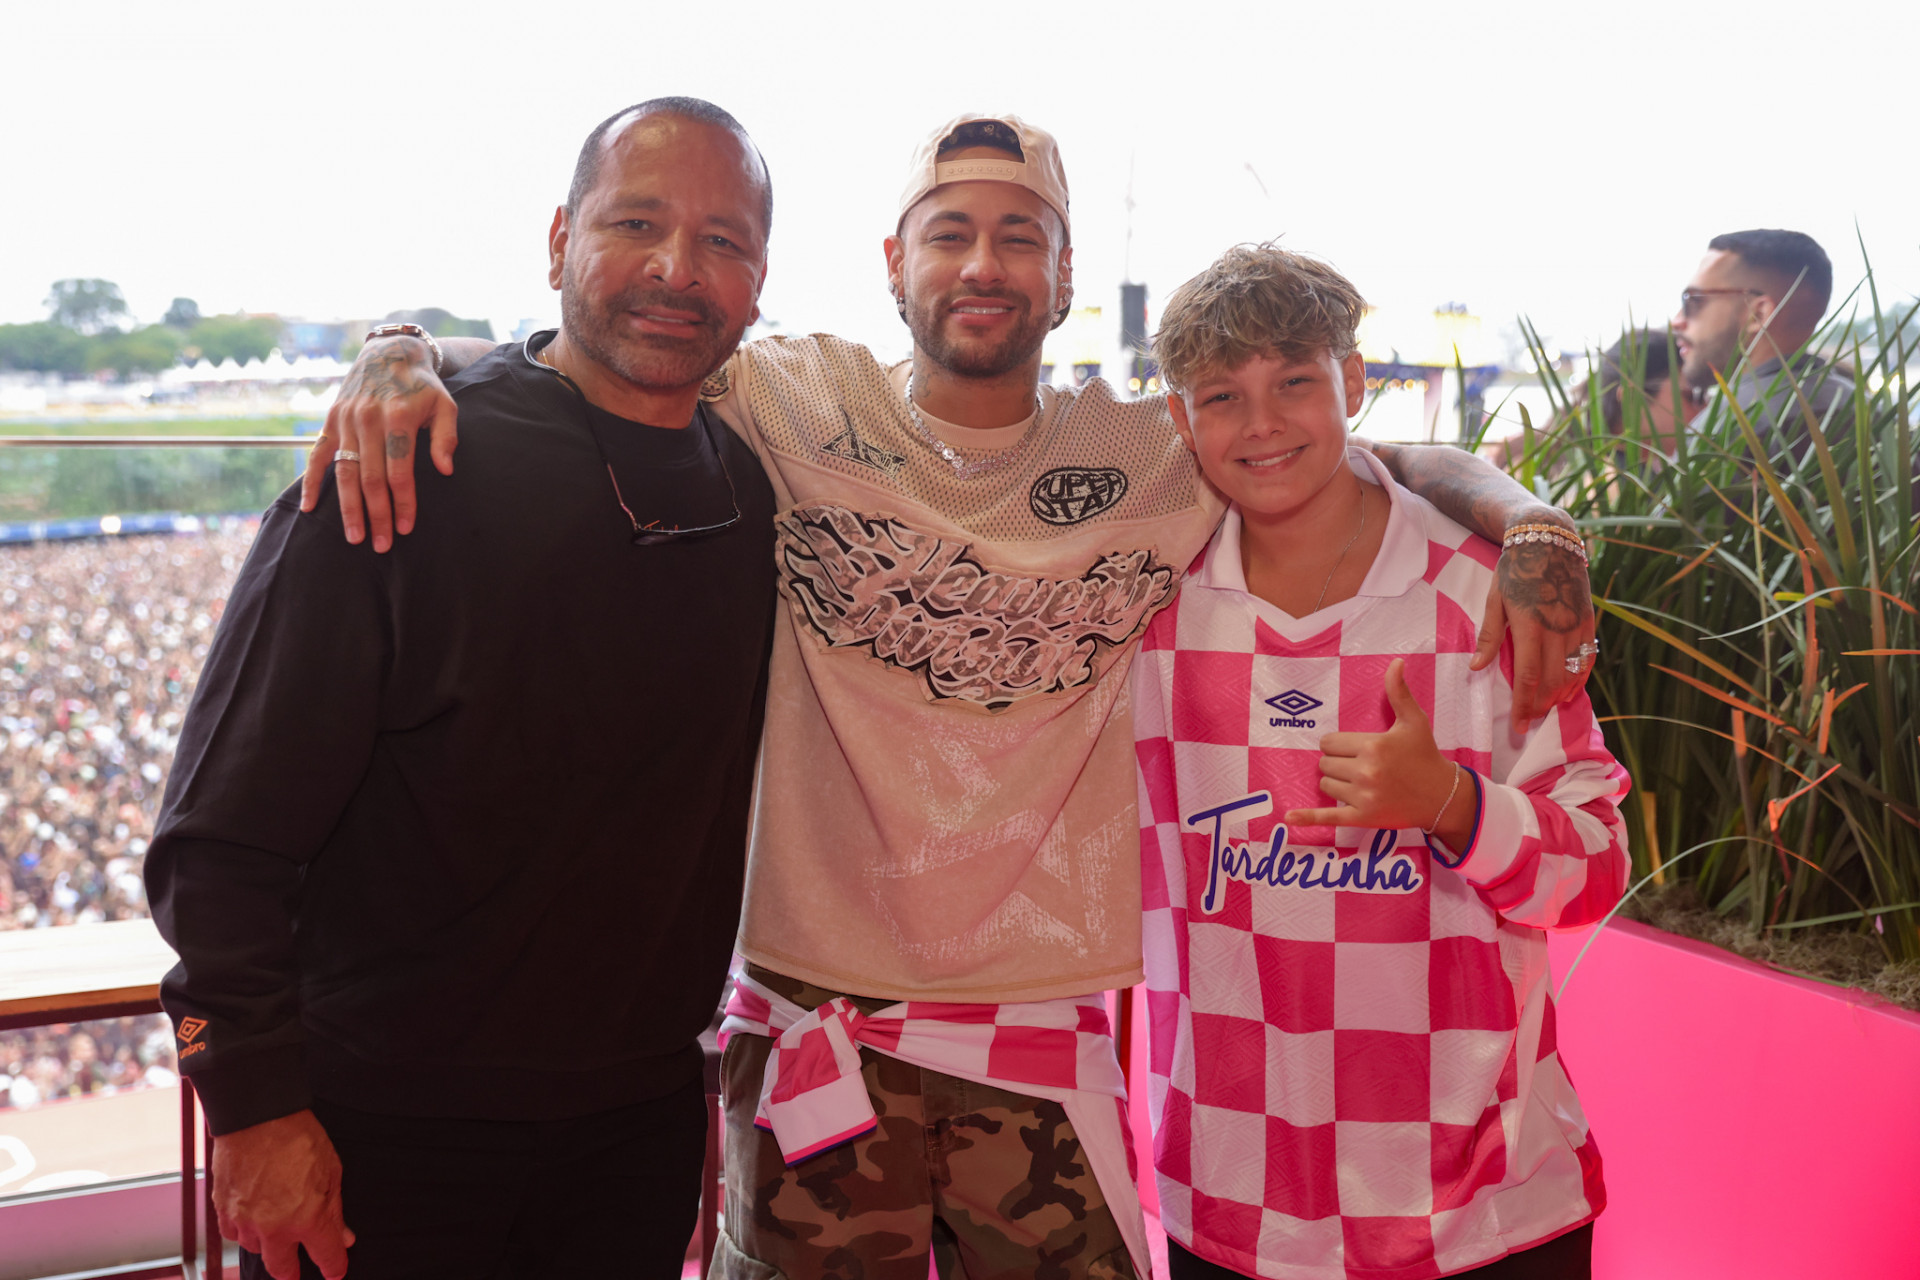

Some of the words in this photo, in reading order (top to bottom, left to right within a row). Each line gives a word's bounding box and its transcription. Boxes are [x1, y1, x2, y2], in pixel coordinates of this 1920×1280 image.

[1034, 472, 1123, 505] SUPER
[1269, 716, 1316, 728] umbro
[1187, 793, 1420, 911] Tardezinha
